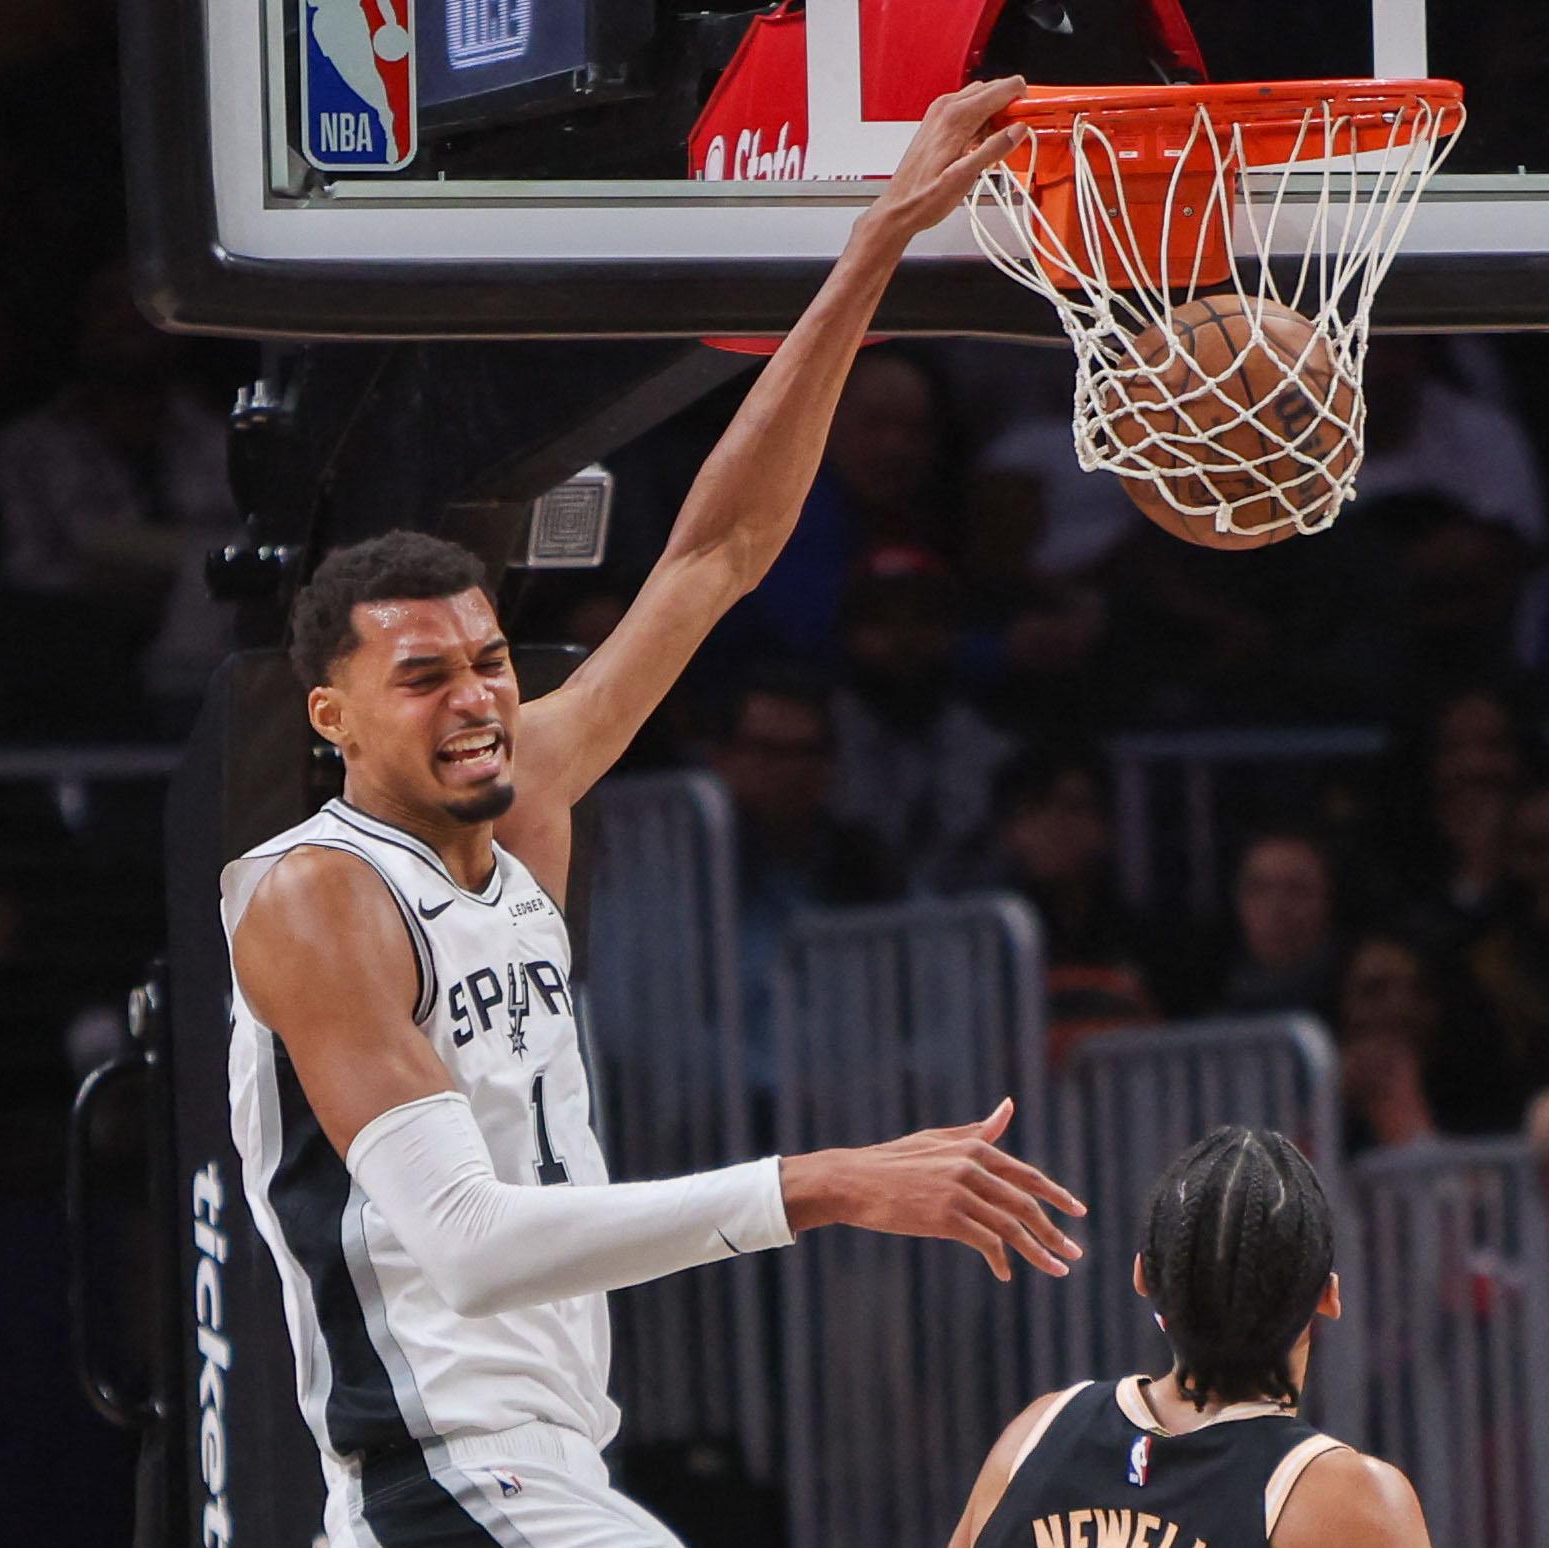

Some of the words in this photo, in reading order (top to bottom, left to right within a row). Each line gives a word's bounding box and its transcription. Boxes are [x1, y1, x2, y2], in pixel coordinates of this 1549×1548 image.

[320, 112, 373, 152] NBA
[508, 898, 545, 917] LEDGER
[449, 960, 573, 1062] SPUR
[527, 1068, 573, 1187] 1
